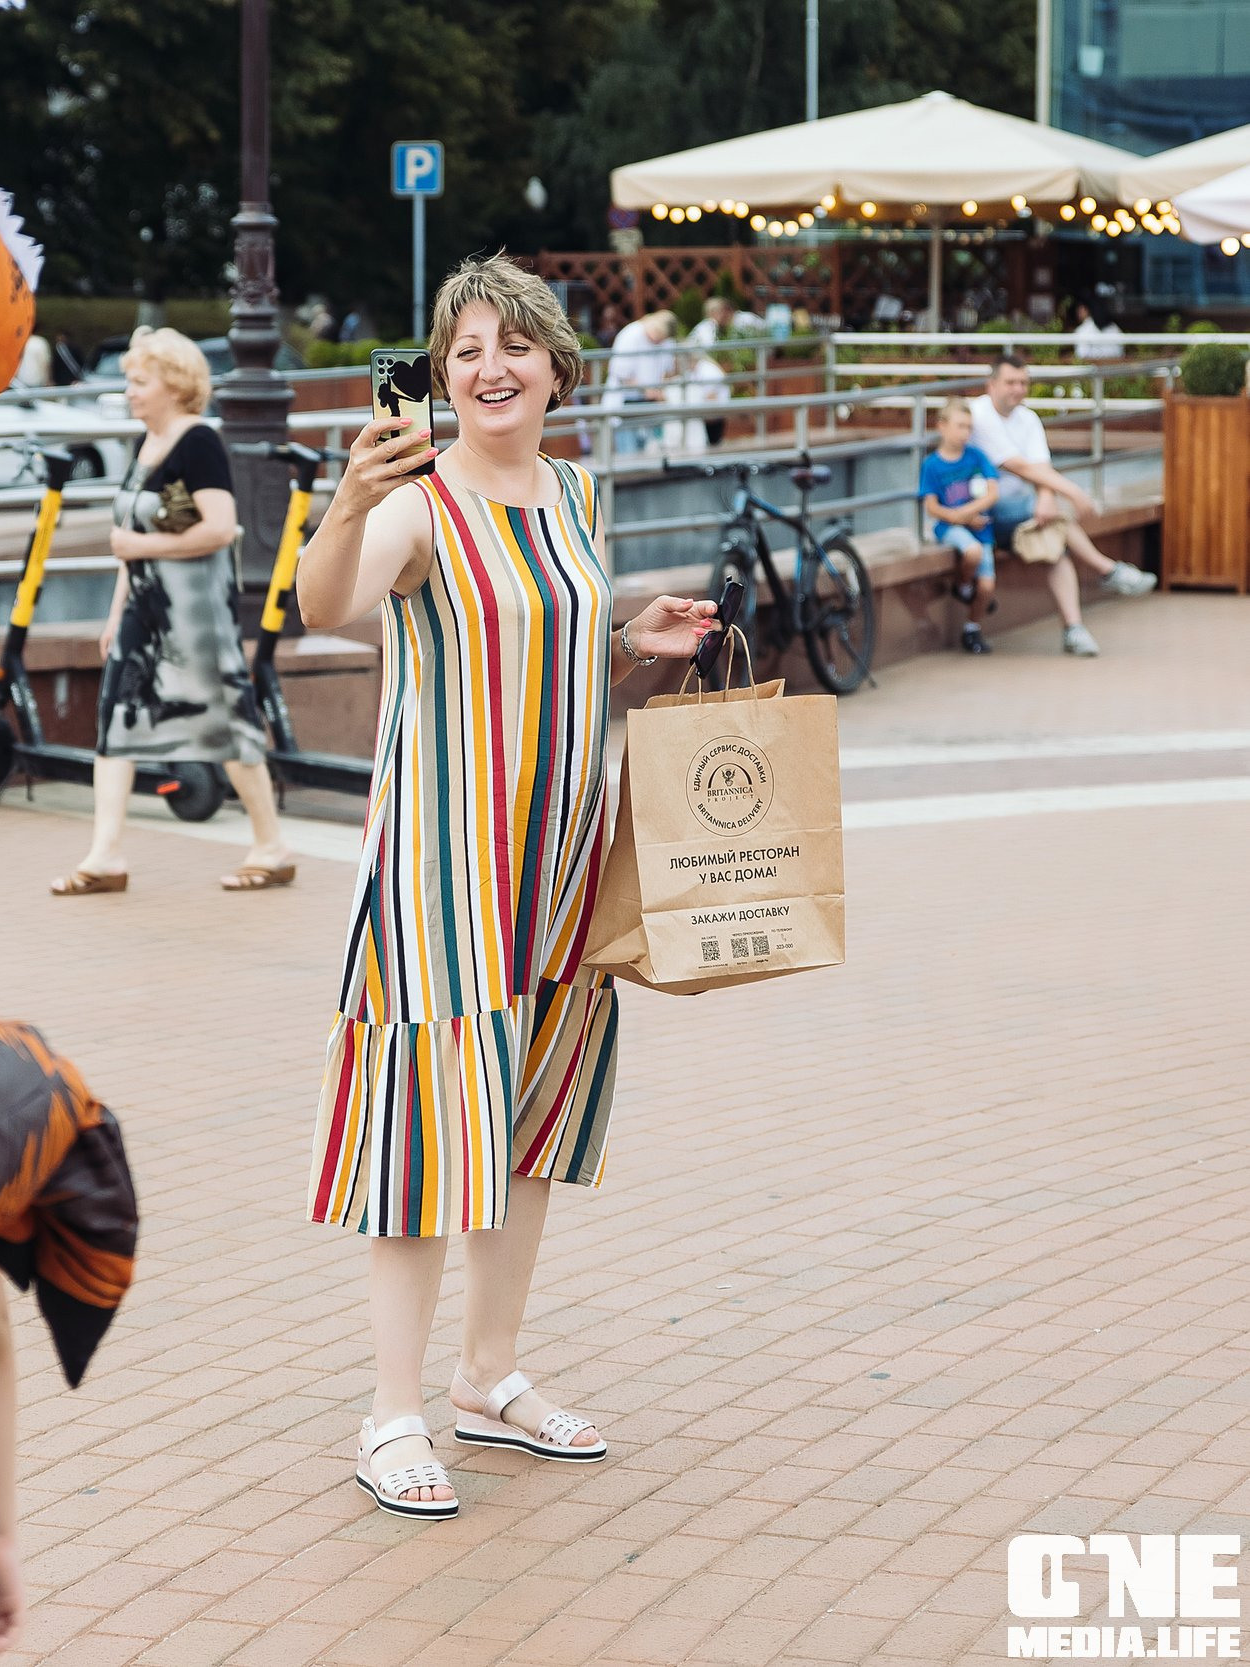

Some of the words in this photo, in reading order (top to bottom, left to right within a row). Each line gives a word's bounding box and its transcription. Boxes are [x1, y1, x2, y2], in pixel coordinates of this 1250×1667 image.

[405, 148, 434, 188] P
[693, 755, 711, 791] ЕДИНЫЙ
[709, 744, 737, 758] СЕРВИС
[736, 746, 767, 784] ДОСТАВКИ
[707, 786, 754, 797] BRITANNICA
[697, 803, 737, 829] BRITANNICA
[737, 798, 764, 827] DELIVERY
[669, 849, 736, 870] ЛЮБИМЫЙ
[739, 845, 800, 863] РЕСТОРАН
[698, 873, 707, 884] У
[710, 870, 732, 884] ВАС
[734, 866, 777, 883] ДОМА!
[691, 911, 736, 925] ЗАКАЖИ
[738, 906, 790, 922] ДОСТАВКУ
